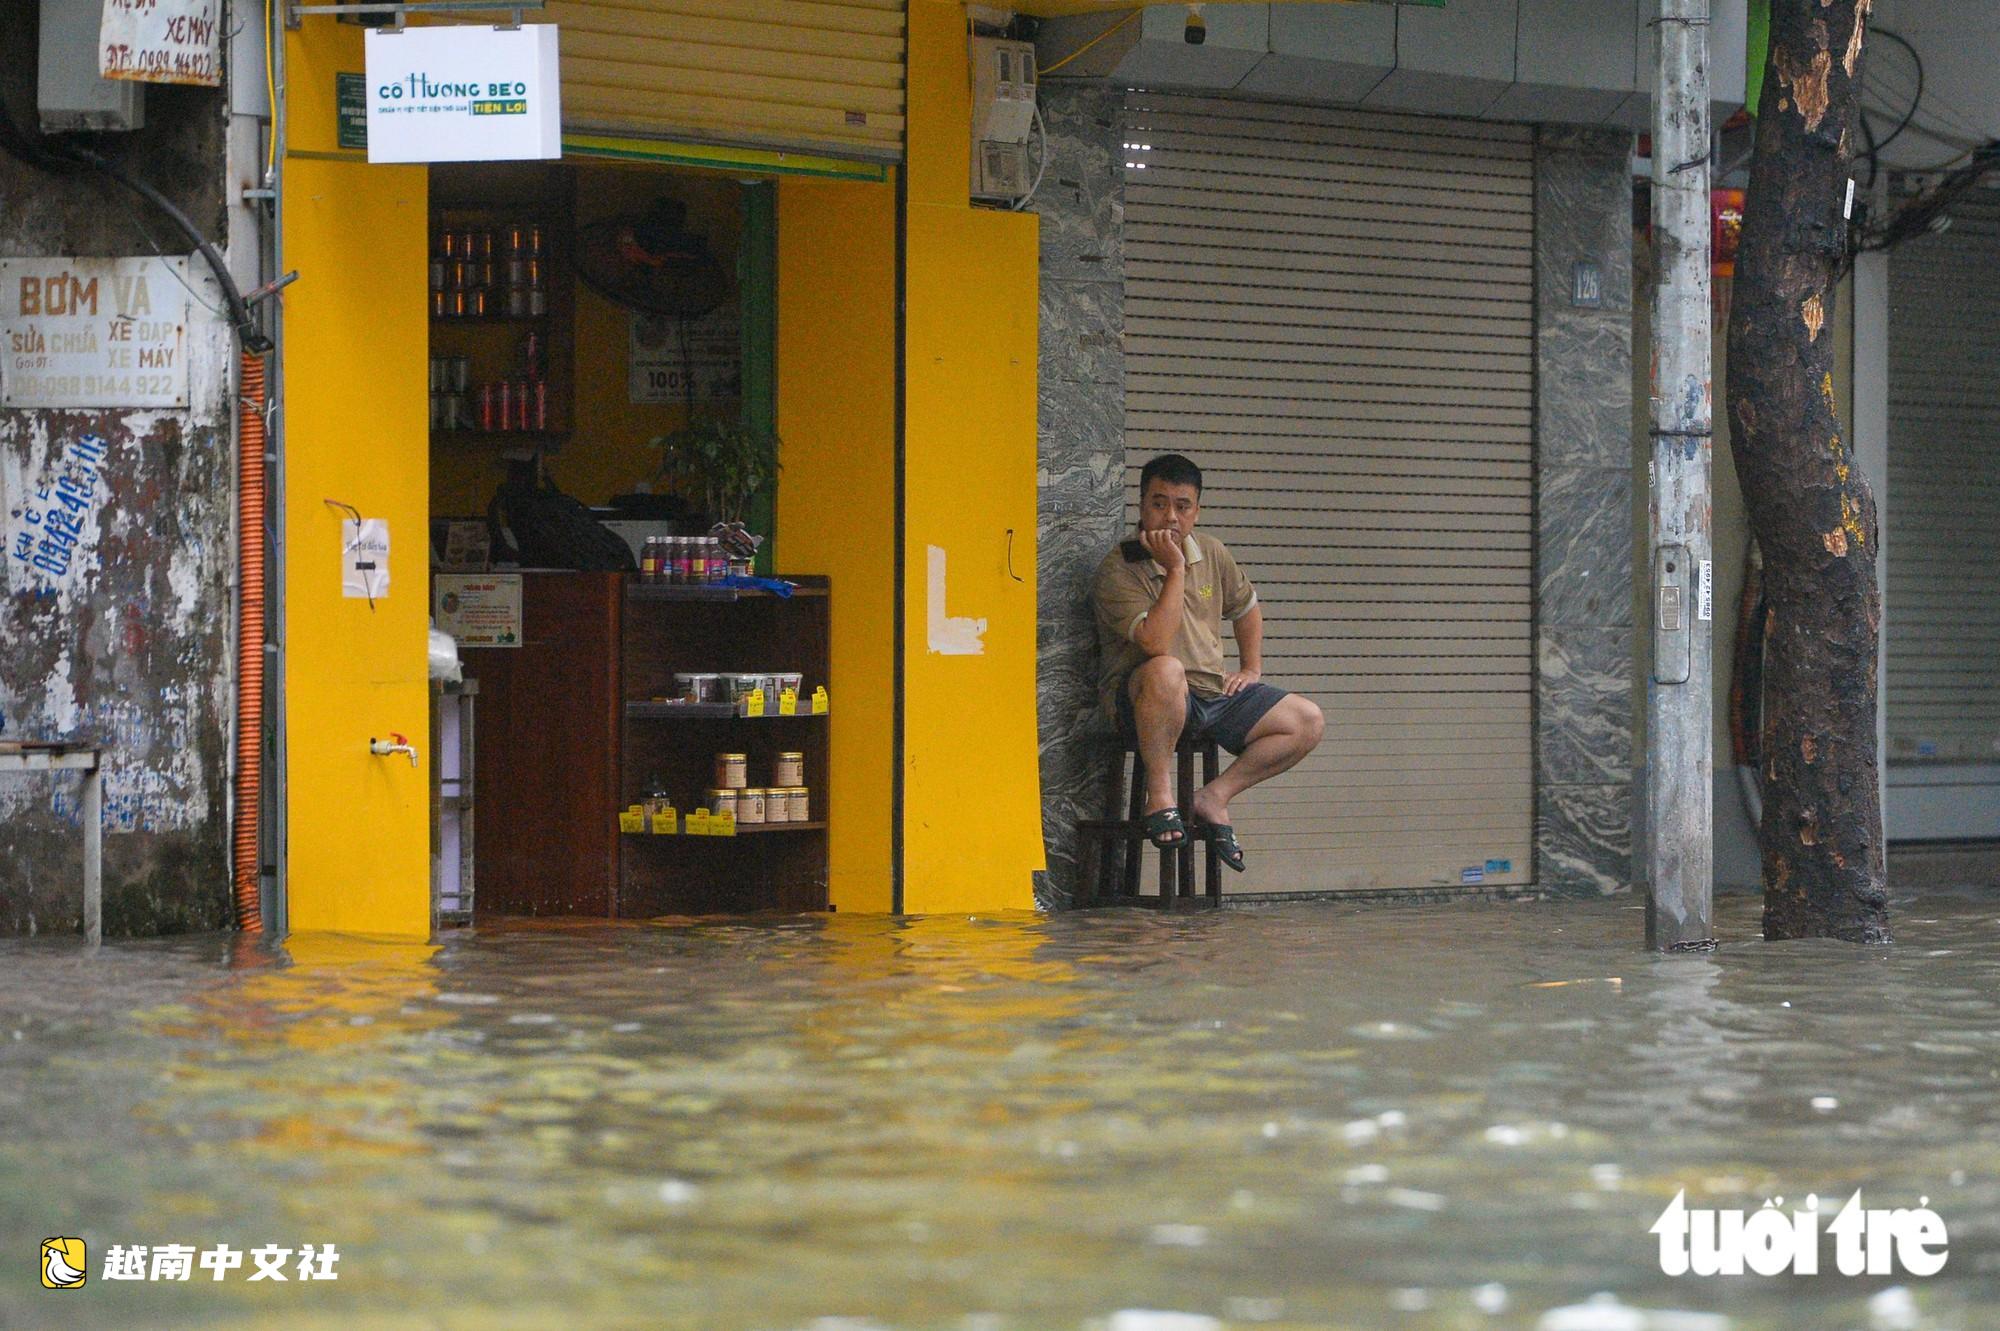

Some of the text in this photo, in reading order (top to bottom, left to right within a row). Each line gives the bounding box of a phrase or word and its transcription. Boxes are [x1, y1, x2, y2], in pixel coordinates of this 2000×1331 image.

[379, 82, 403, 98] CÔ
[20, 261, 151, 316] BƠM VÁ
[139, 342, 174, 368] MÁY
